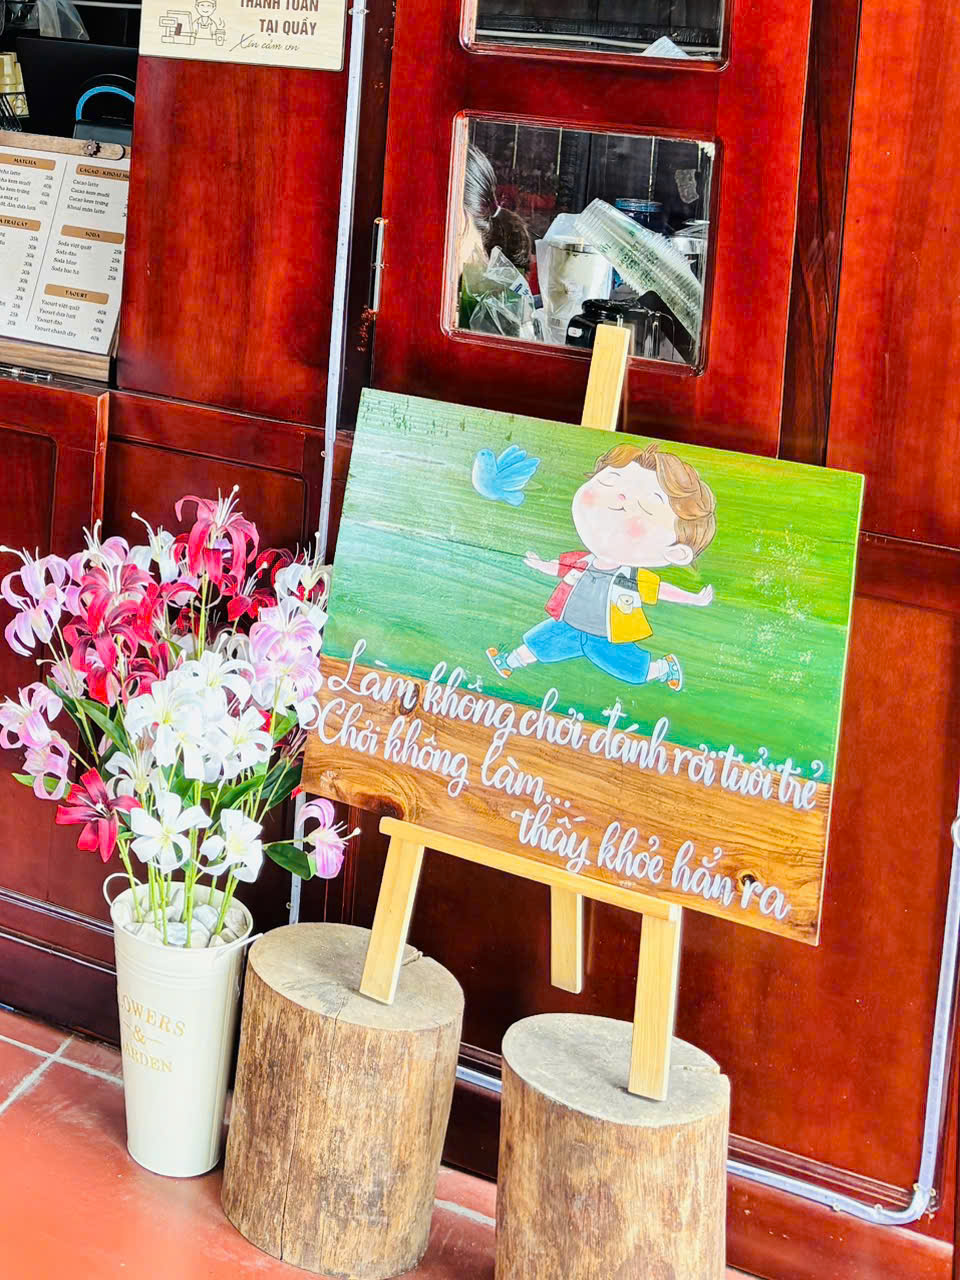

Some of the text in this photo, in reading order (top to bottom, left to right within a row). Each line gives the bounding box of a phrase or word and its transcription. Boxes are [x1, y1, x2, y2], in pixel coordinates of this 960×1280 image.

[228, 33, 258, 52] Xin
[259, 16, 317, 37] TẠI QUẦY
[384, 716, 470, 798] không
[589, 696, 670, 775] đánh
[775, 757, 826, 811] trẻ
[511, 803, 592, 874] thấy
[740, 880, 792, 921] ra
[121, 994, 186, 1037] OWERS
